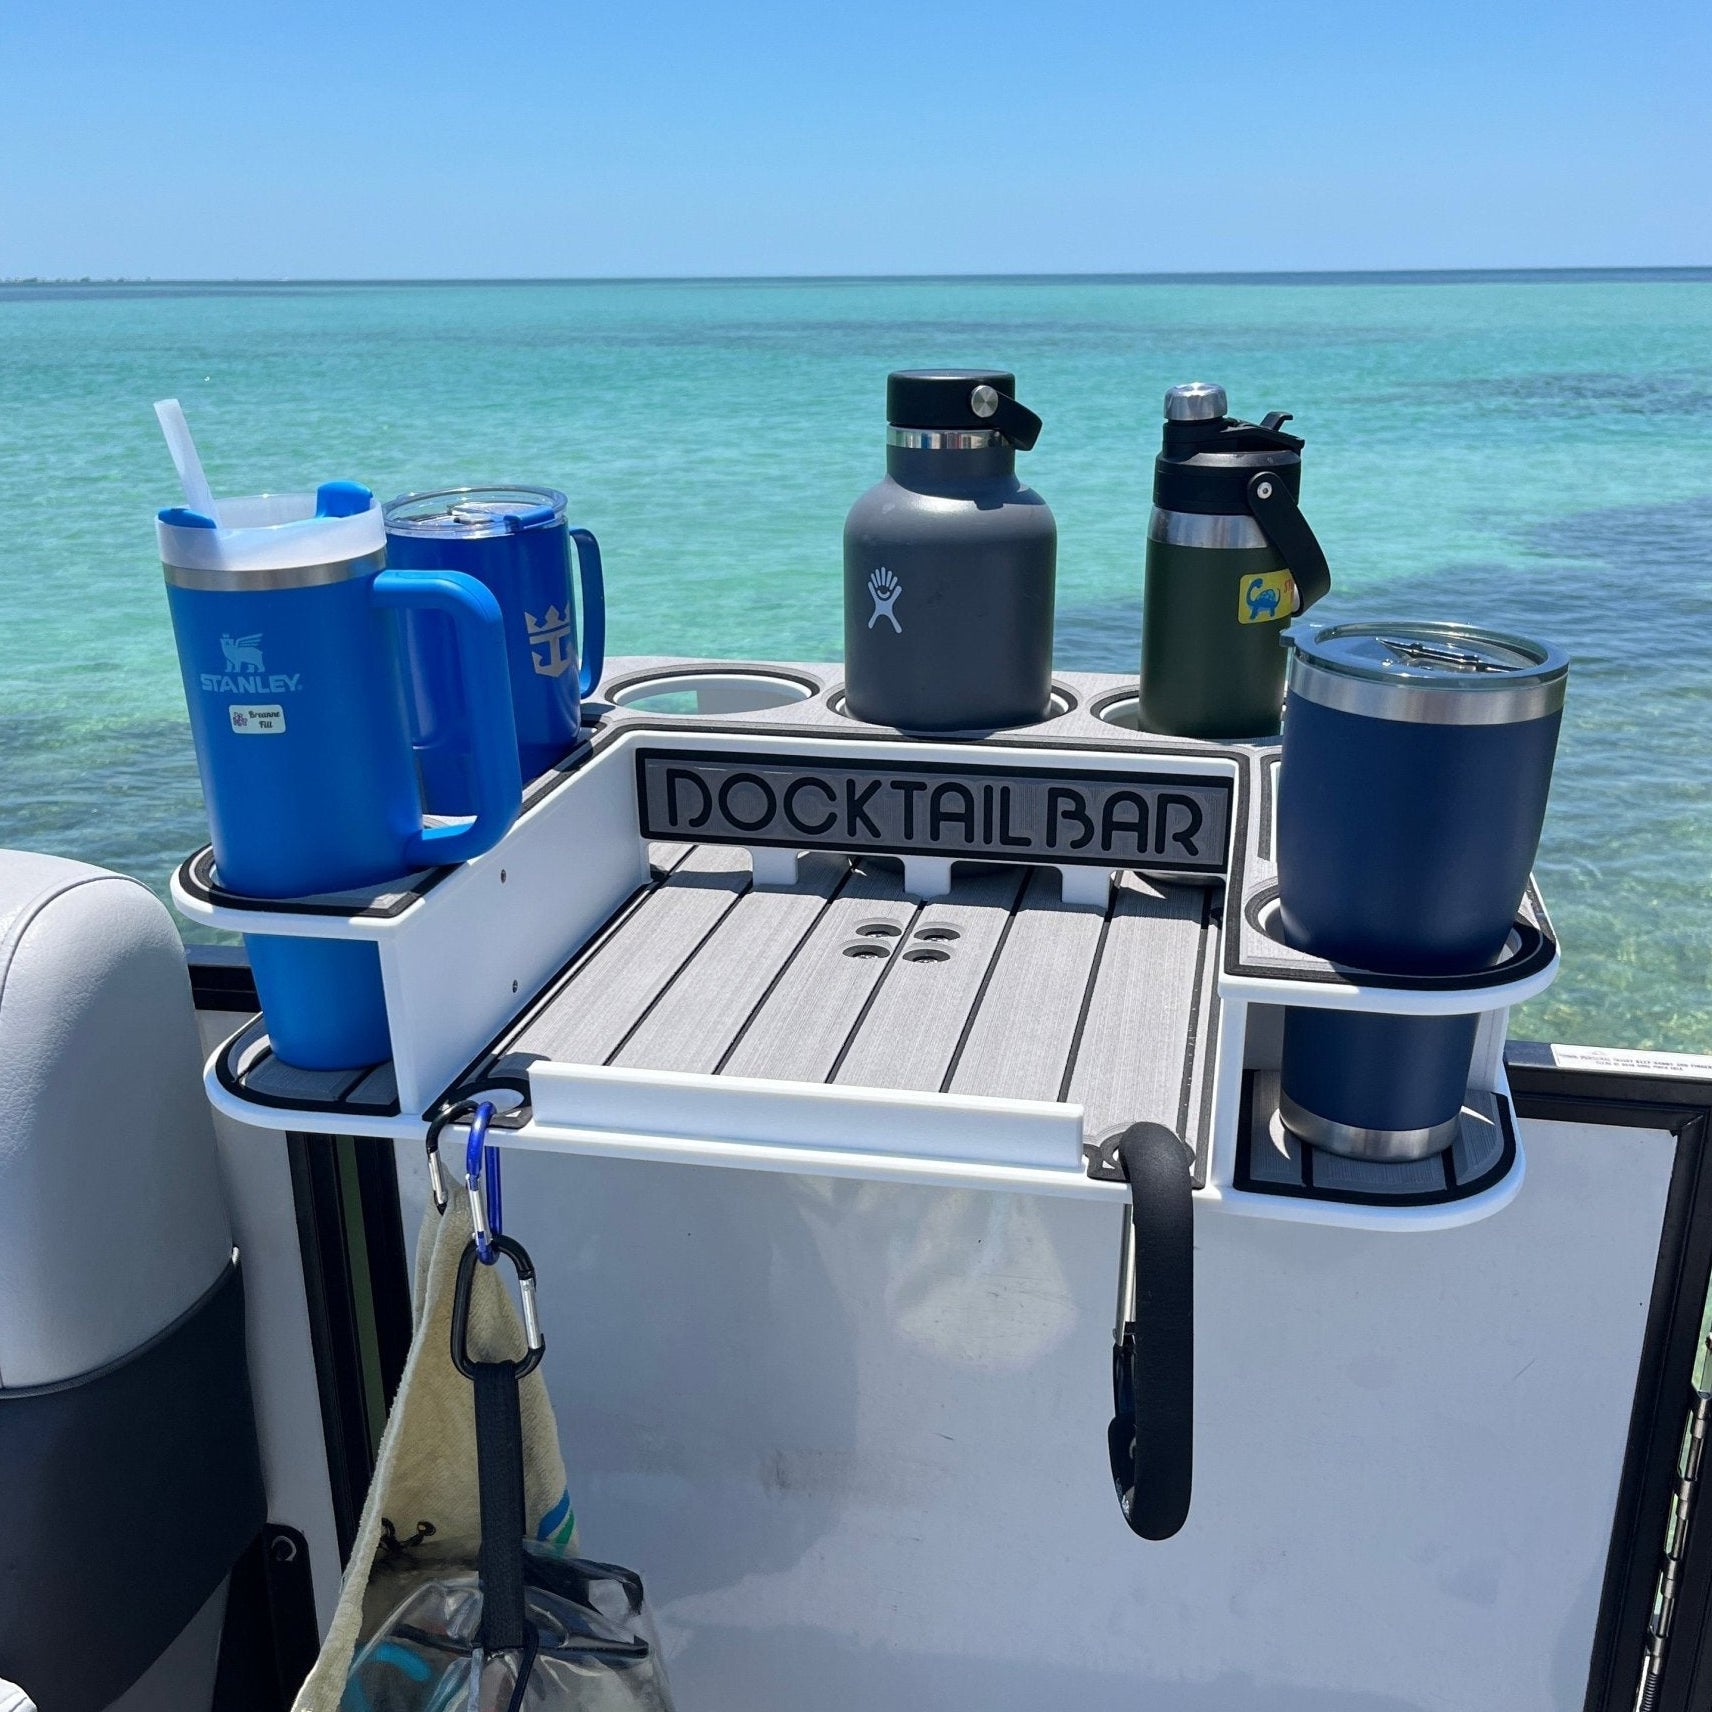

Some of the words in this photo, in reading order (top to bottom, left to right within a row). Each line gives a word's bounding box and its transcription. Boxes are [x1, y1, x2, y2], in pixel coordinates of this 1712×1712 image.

[200, 673, 301, 694] STANLEY
[666, 768, 1032, 847] DOCKTAIL
[1046, 787, 1203, 857] BAR
